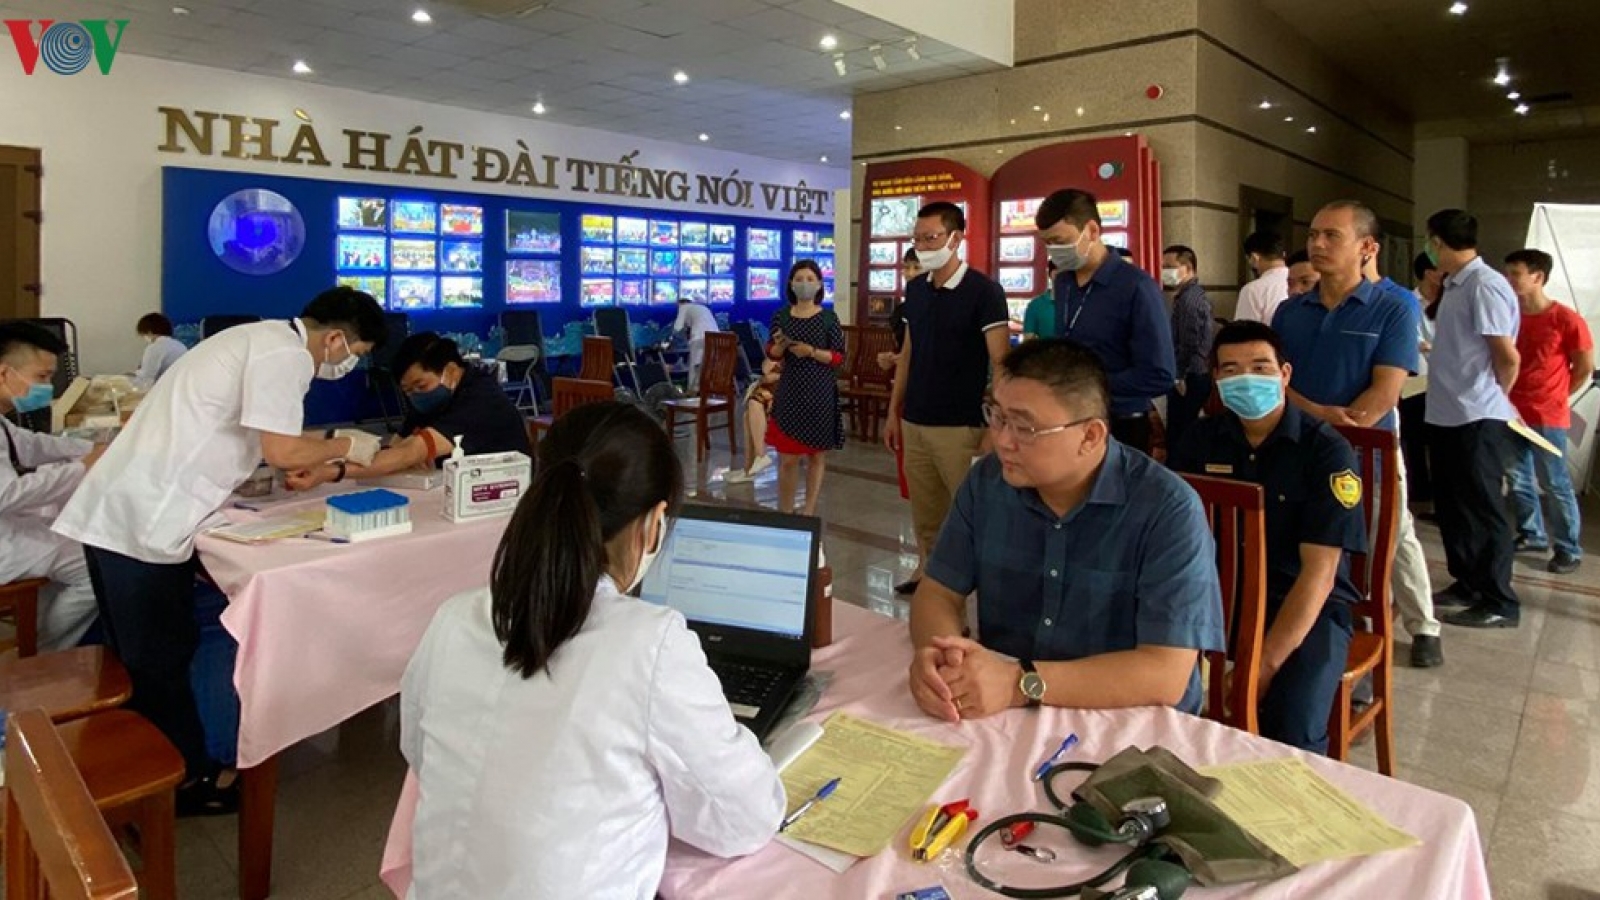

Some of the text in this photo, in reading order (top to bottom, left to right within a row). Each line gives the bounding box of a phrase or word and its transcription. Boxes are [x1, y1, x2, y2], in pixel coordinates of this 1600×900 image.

[157, 105, 331, 167] NHÀ
[342, 125, 464, 179] HÁT
[471, 139, 560, 190] ĐÀI
[566, 149, 690, 203] TIẾNG
[696, 168, 754, 209] NÓI
[760, 179, 829, 220] VIỆT
